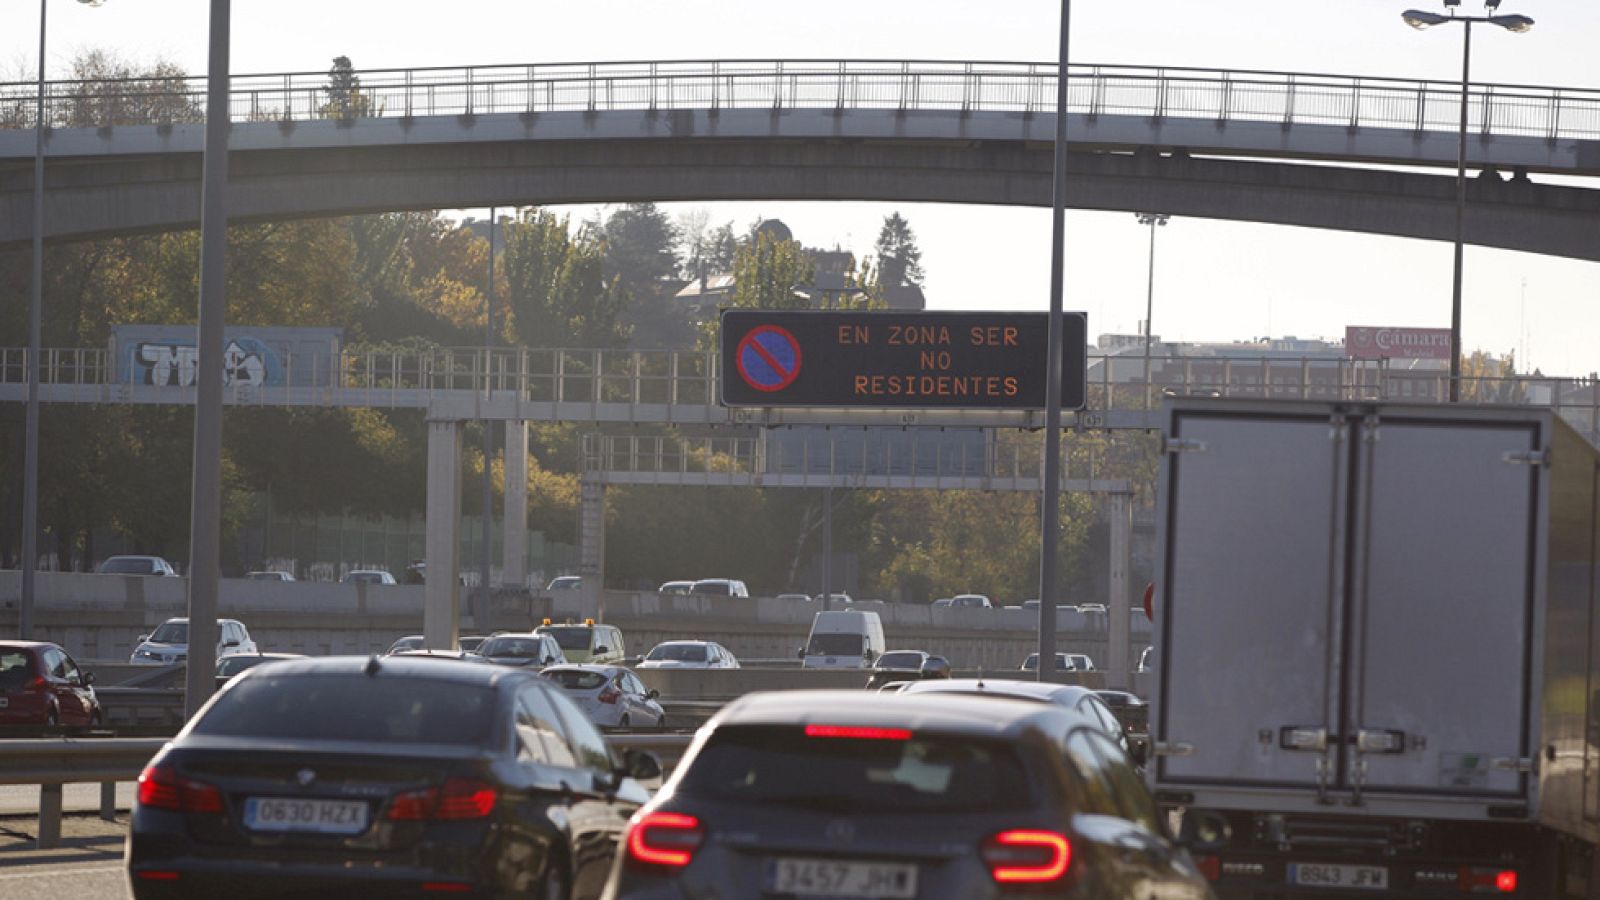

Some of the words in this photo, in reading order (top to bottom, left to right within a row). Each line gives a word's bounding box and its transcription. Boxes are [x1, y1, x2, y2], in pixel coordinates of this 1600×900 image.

[838, 326, 869, 344] EN
[888, 326, 951, 345] ZONA
[971, 327, 1019, 346] SER
[920, 351, 951, 370] NO
[854, 376, 1019, 396] RESIDENTES
[261, 801, 314, 822] 0630
[319, 803, 361, 824] HZX
[783, 862, 850, 890] 3457
